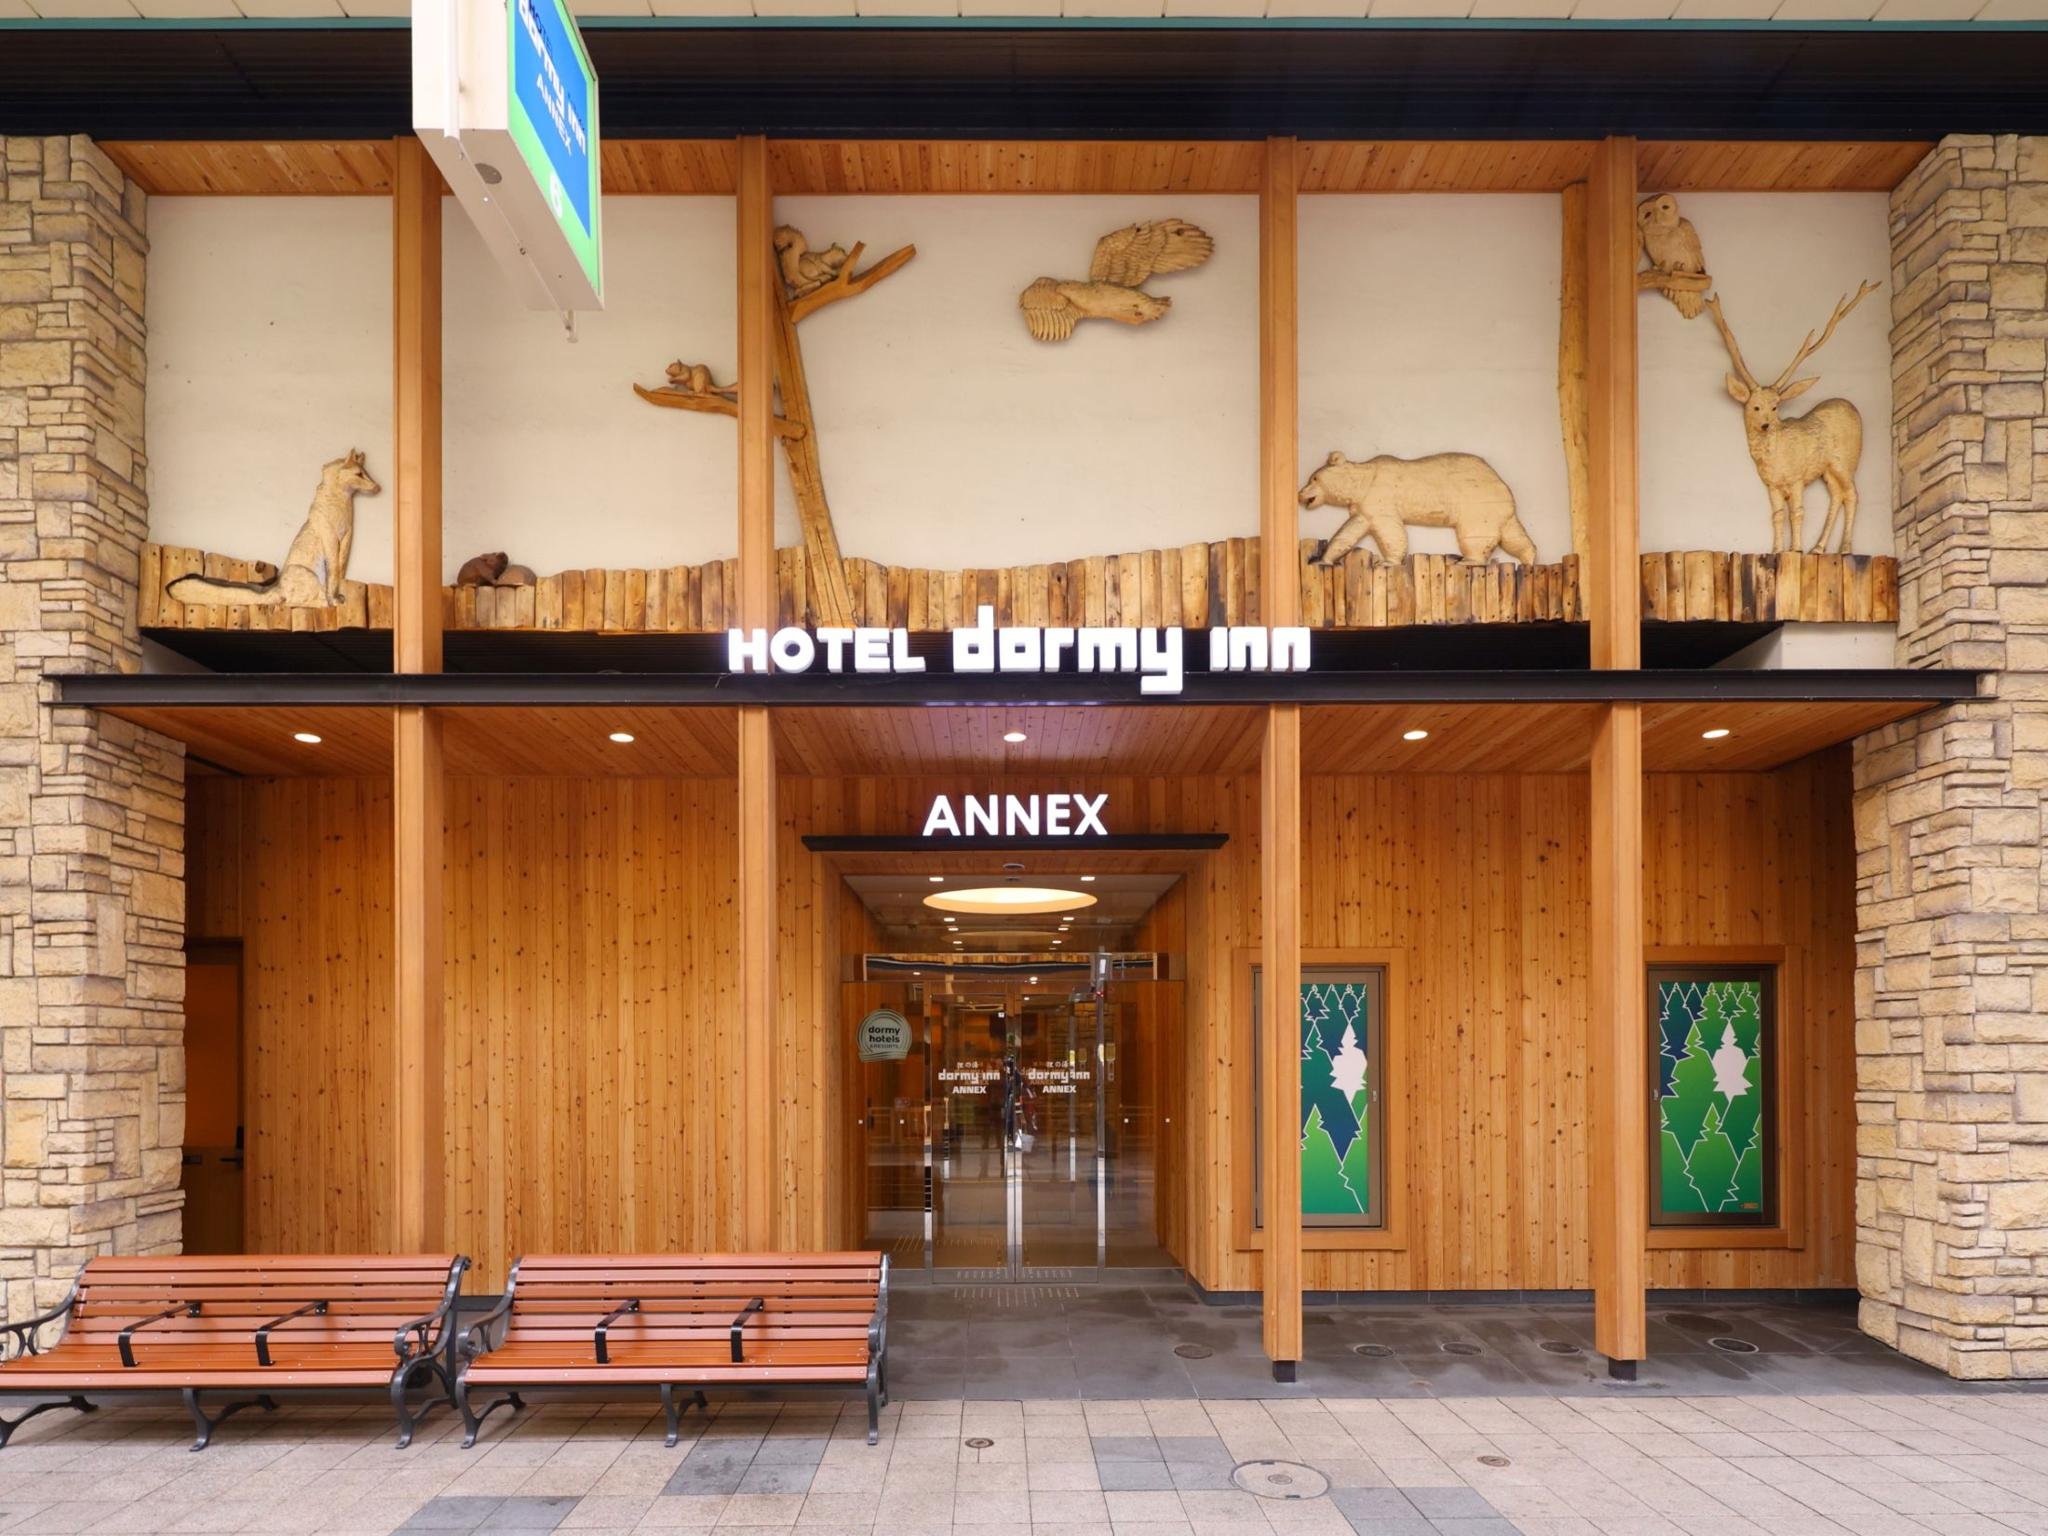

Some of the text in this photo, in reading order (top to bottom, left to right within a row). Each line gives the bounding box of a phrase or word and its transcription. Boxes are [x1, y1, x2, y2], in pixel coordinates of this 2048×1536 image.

[519, 0, 565, 119] dormy
[568, 101, 586, 156] inn
[536, 72, 571, 156] ANNEX
[727, 605, 1311, 695] HOTEL dormy inn
[922, 794, 1109, 836] ANNEX
[868, 1025, 901, 1036] dormy
[869, 1035, 900, 1043] hotels
[938, 1068, 1000, 1085] dormy inn
[1028, 1068, 1069, 1084] dormy
[952, 1085, 987, 1094] ANNEX
[1042, 1085, 1077, 1094] ANNEX
